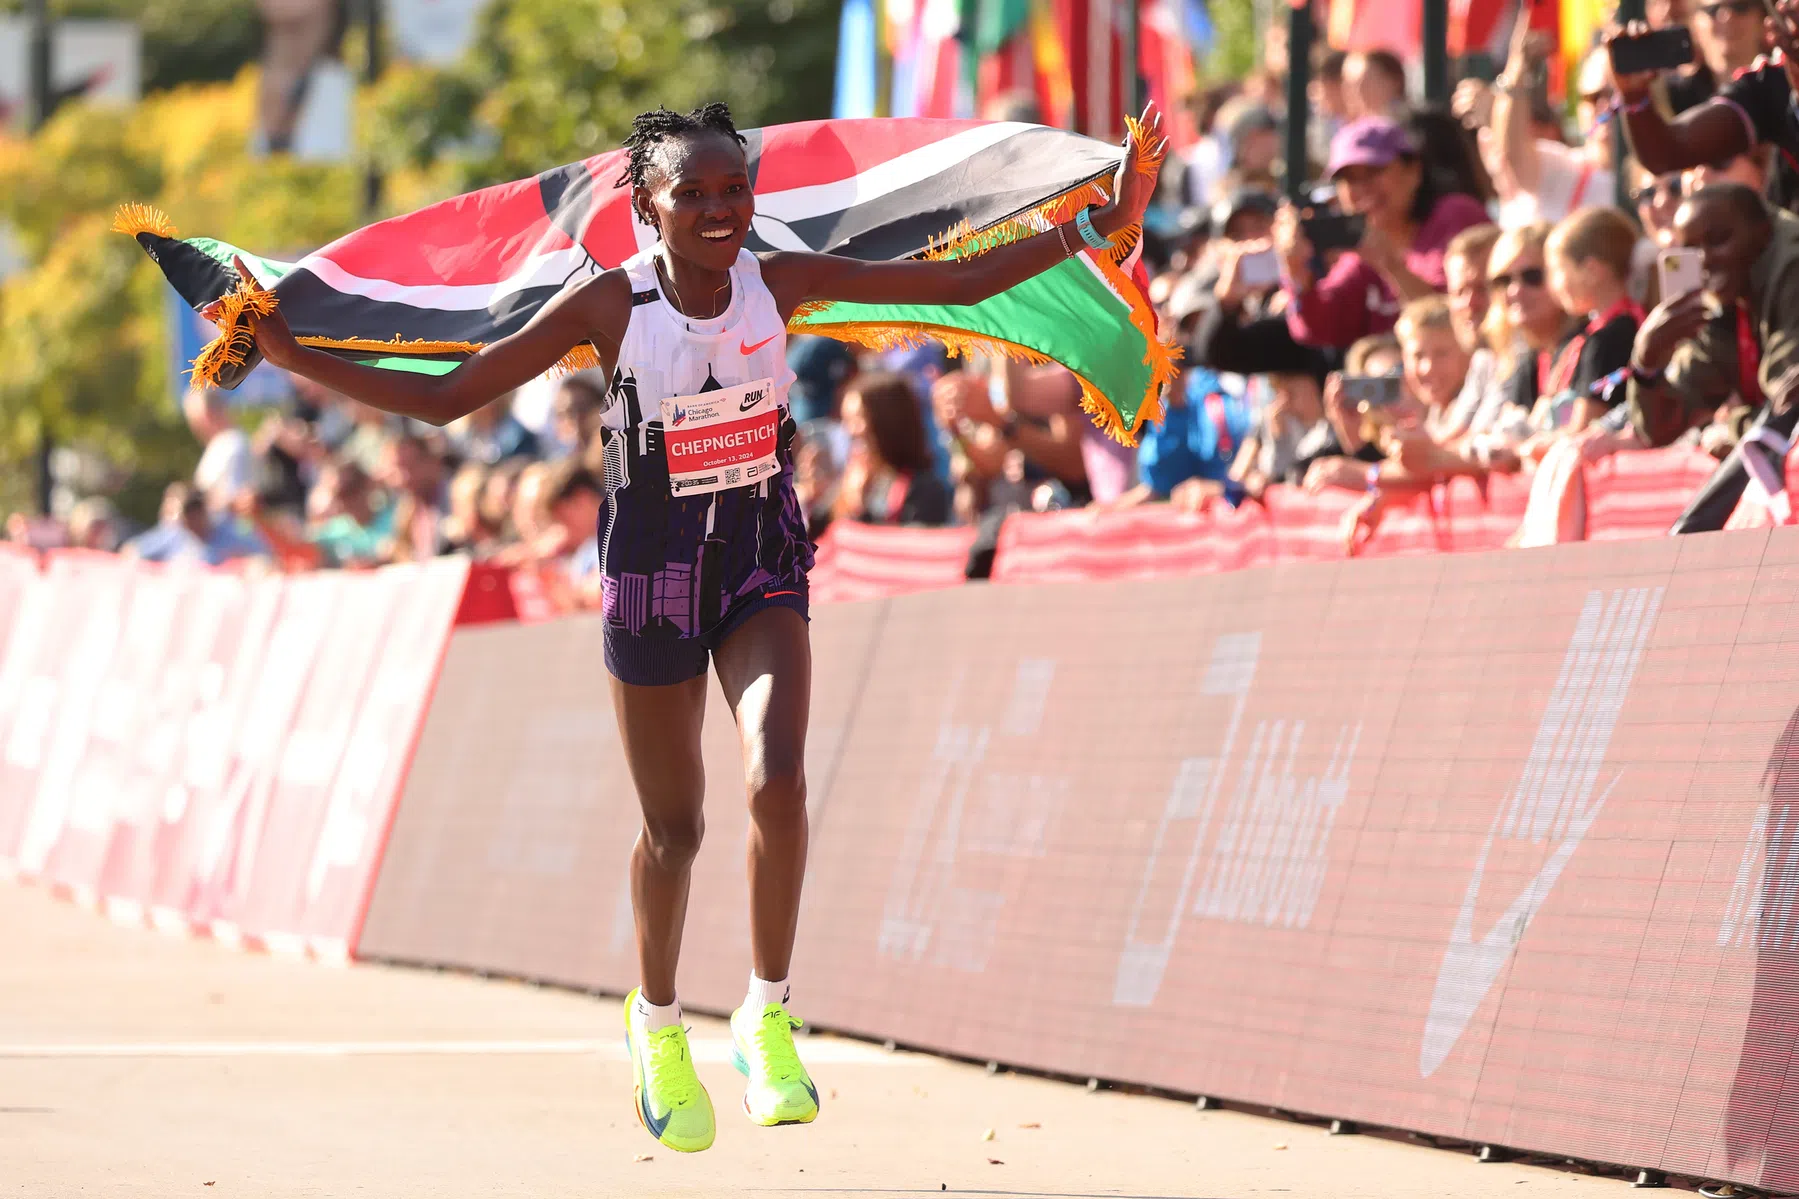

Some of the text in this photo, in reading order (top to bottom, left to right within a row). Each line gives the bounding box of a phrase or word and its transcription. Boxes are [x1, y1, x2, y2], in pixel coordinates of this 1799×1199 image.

[743, 389, 763, 404] RUN
[688, 407, 713, 416] Chicago
[671, 422, 776, 457] CHEPNGETICH
[703, 457, 727, 467] October
[739, 452, 754, 460] 2024
